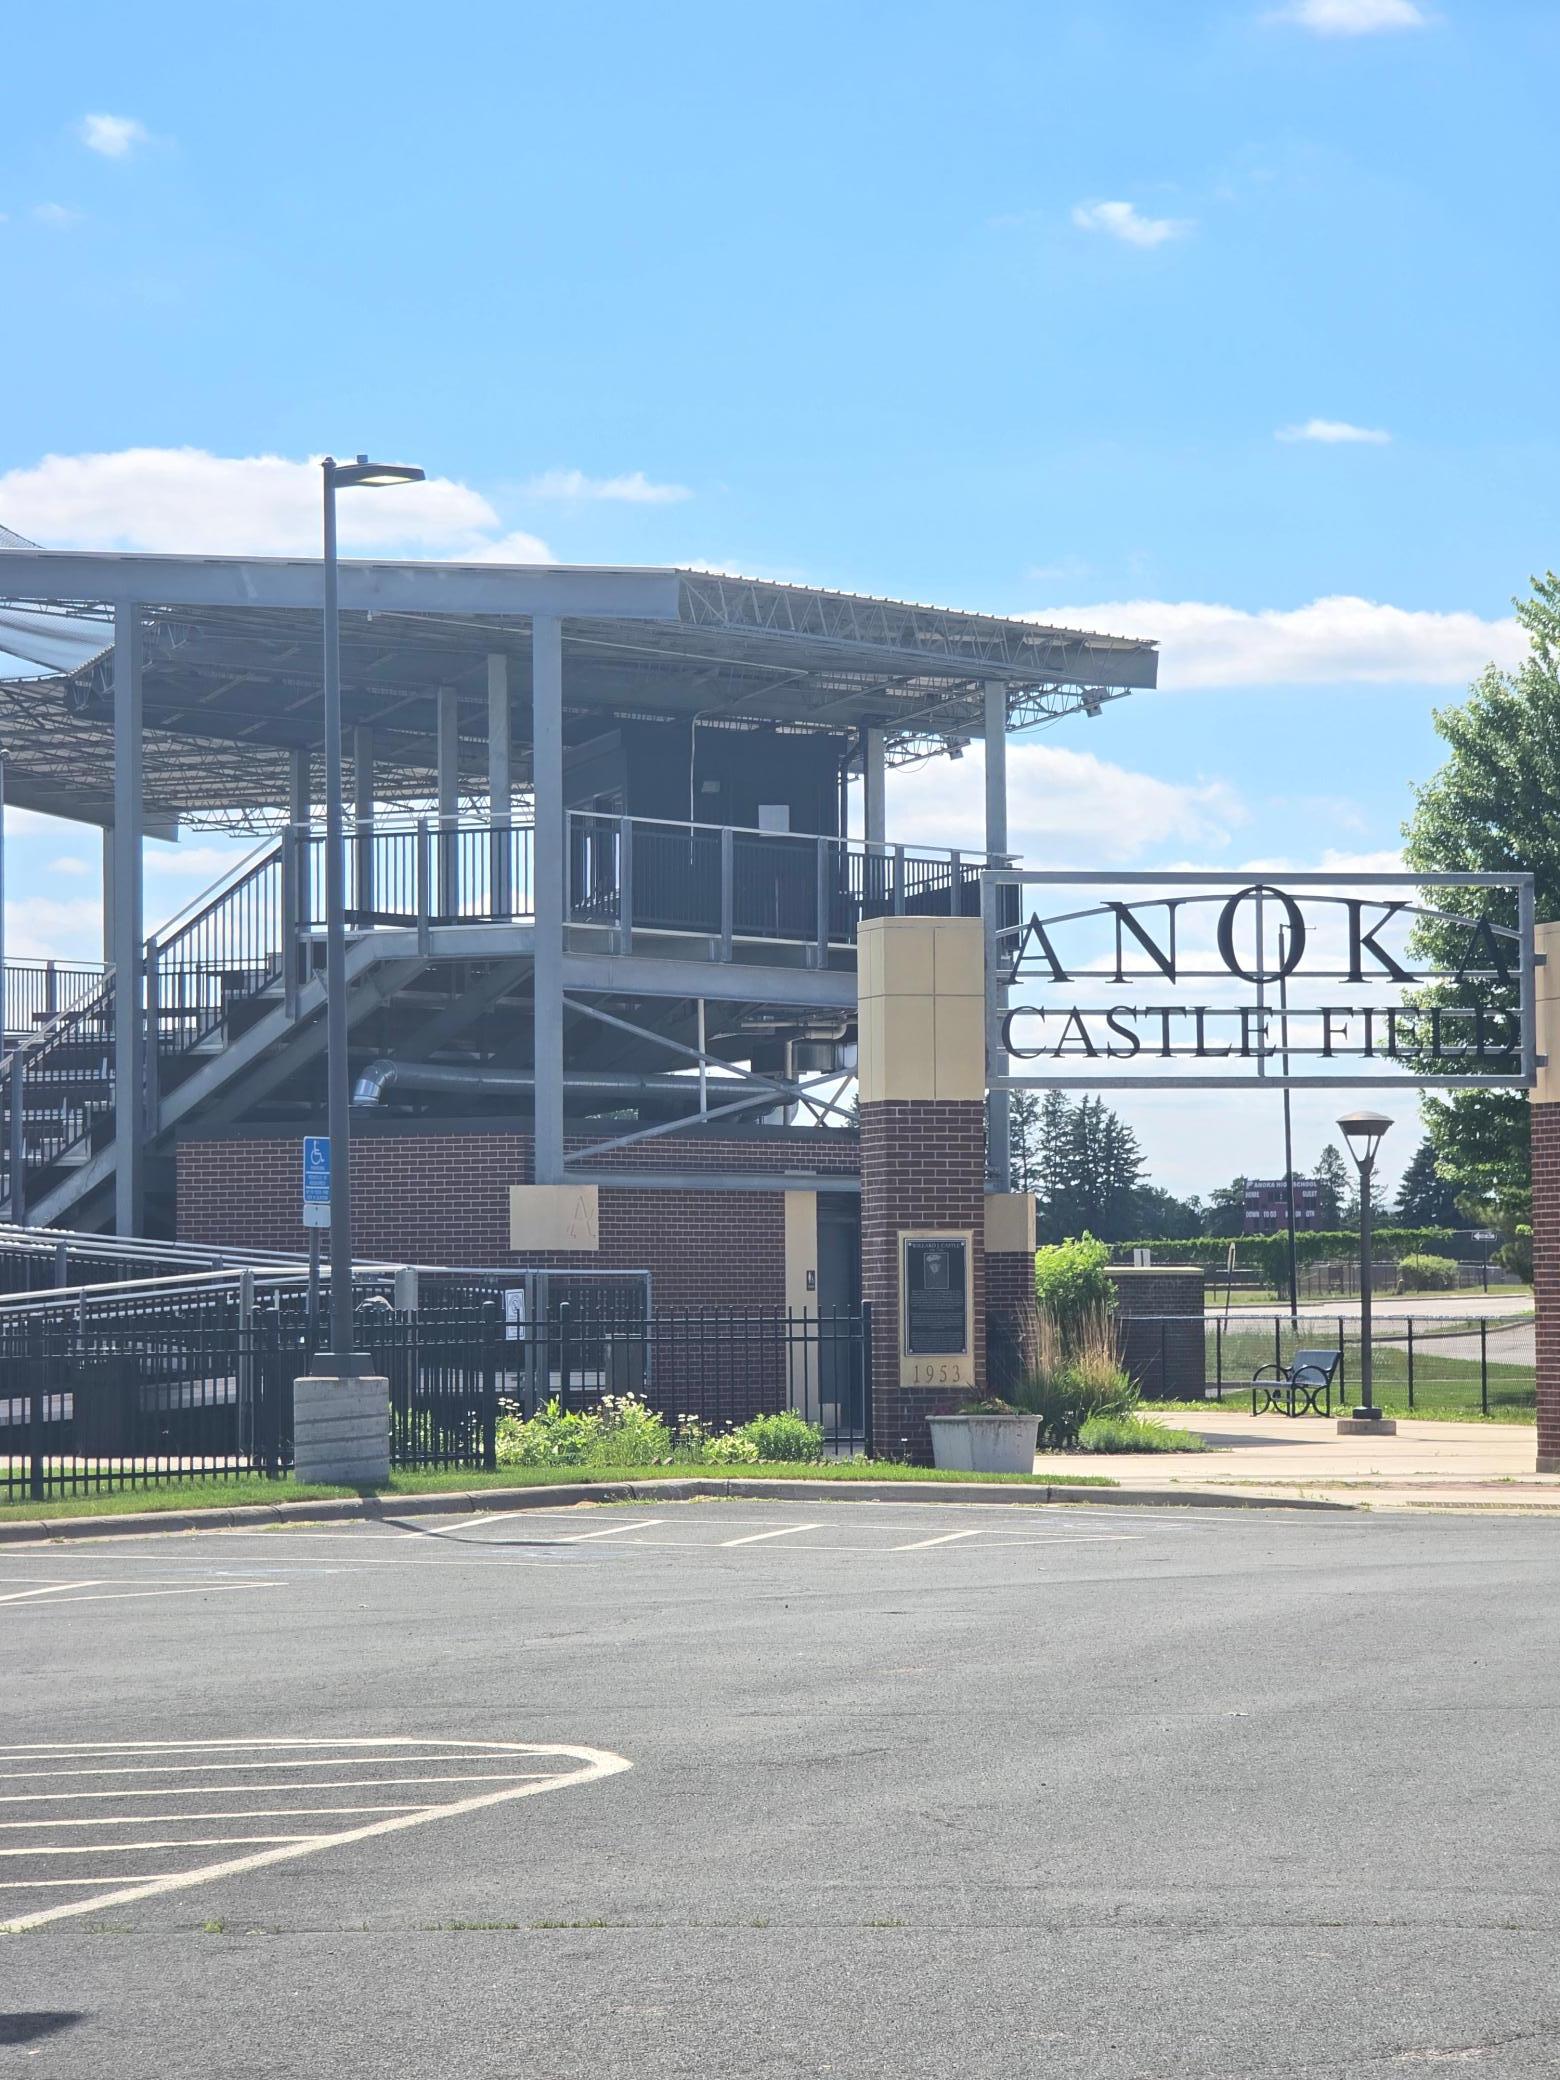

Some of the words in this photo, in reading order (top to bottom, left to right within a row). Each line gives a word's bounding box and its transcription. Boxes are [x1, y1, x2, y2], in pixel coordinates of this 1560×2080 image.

[1006, 886, 1513, 985] ANOKA
[1001, 1005, 1277, 1059] CASTLE
[1319, 1006, 1520, 1059] FIELD
[913, 1364, 961, 1384] 1953
